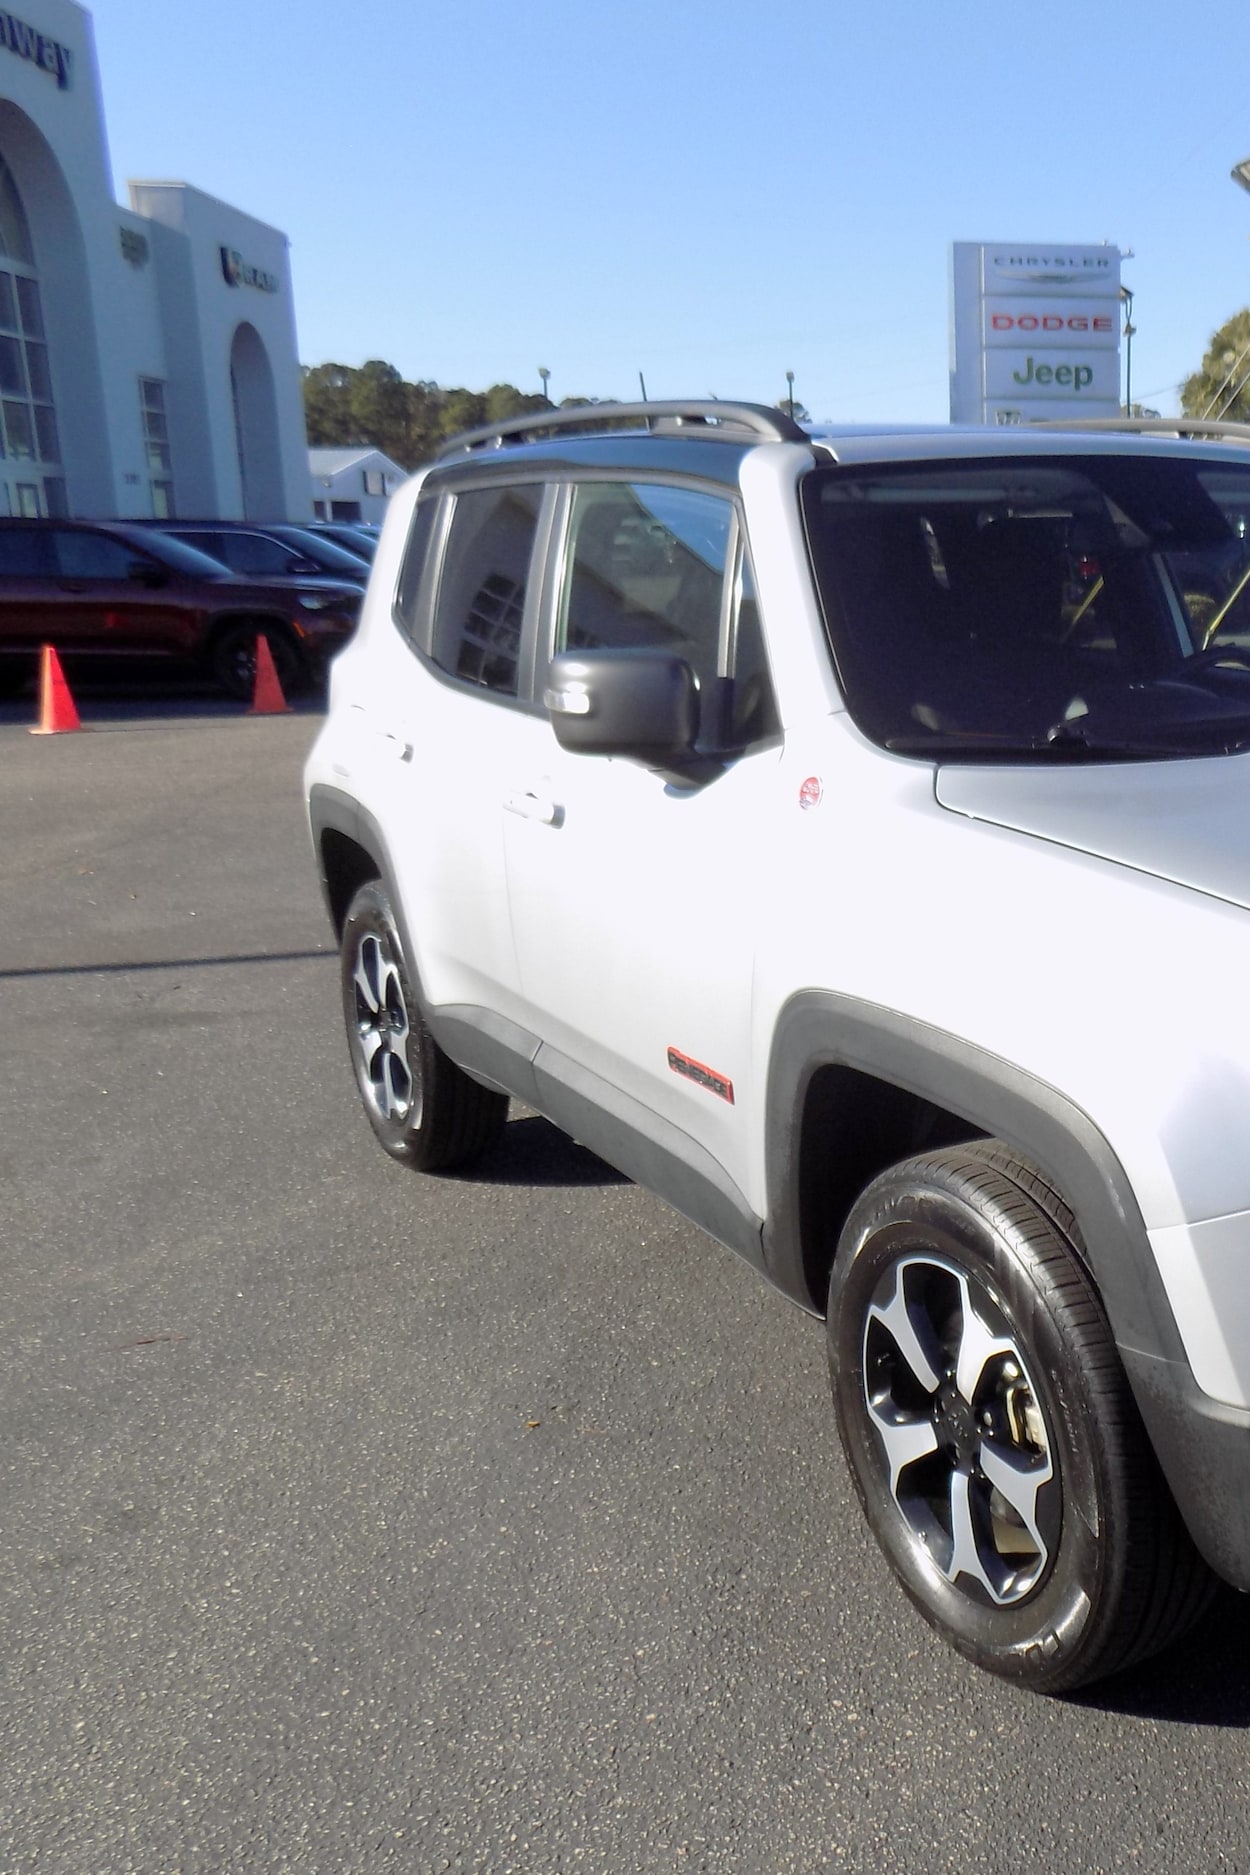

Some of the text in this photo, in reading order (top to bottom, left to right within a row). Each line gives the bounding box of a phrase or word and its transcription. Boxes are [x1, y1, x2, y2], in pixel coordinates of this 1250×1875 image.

[993, 254, 1110, 268] CHRYSLER
[991, 313, 1113, 332] DODGE
[1012, 356, 1094, 392] Jeep
